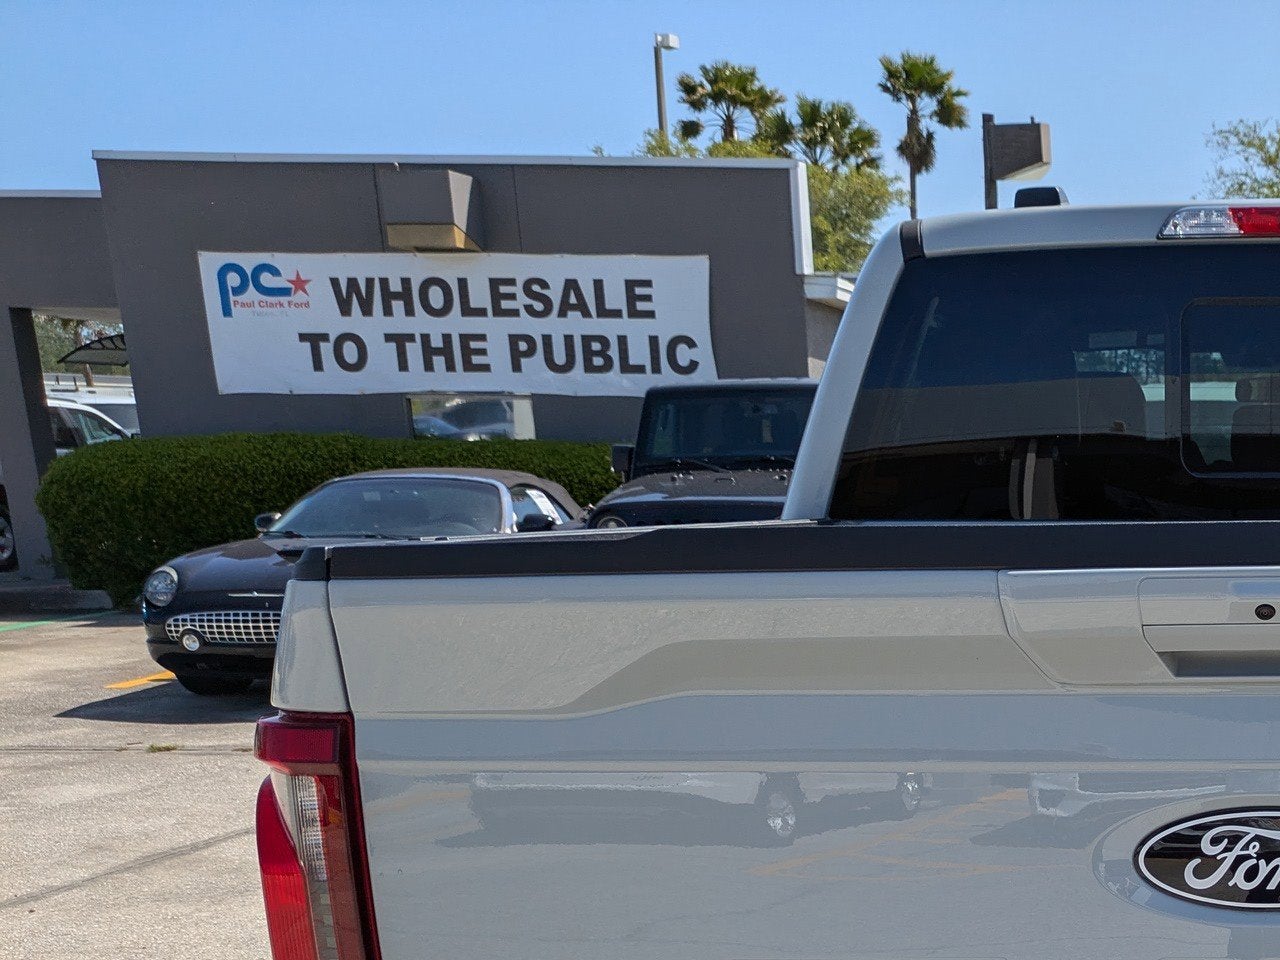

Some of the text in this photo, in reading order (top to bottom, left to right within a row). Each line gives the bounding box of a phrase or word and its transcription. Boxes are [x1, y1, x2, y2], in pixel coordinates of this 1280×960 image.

[233, 300, 311, 309] Paul Clark Ford
[329, 277, 656, 320] WHOLESALE
[298, 332, 700, 375] TO THE PUBLIC
